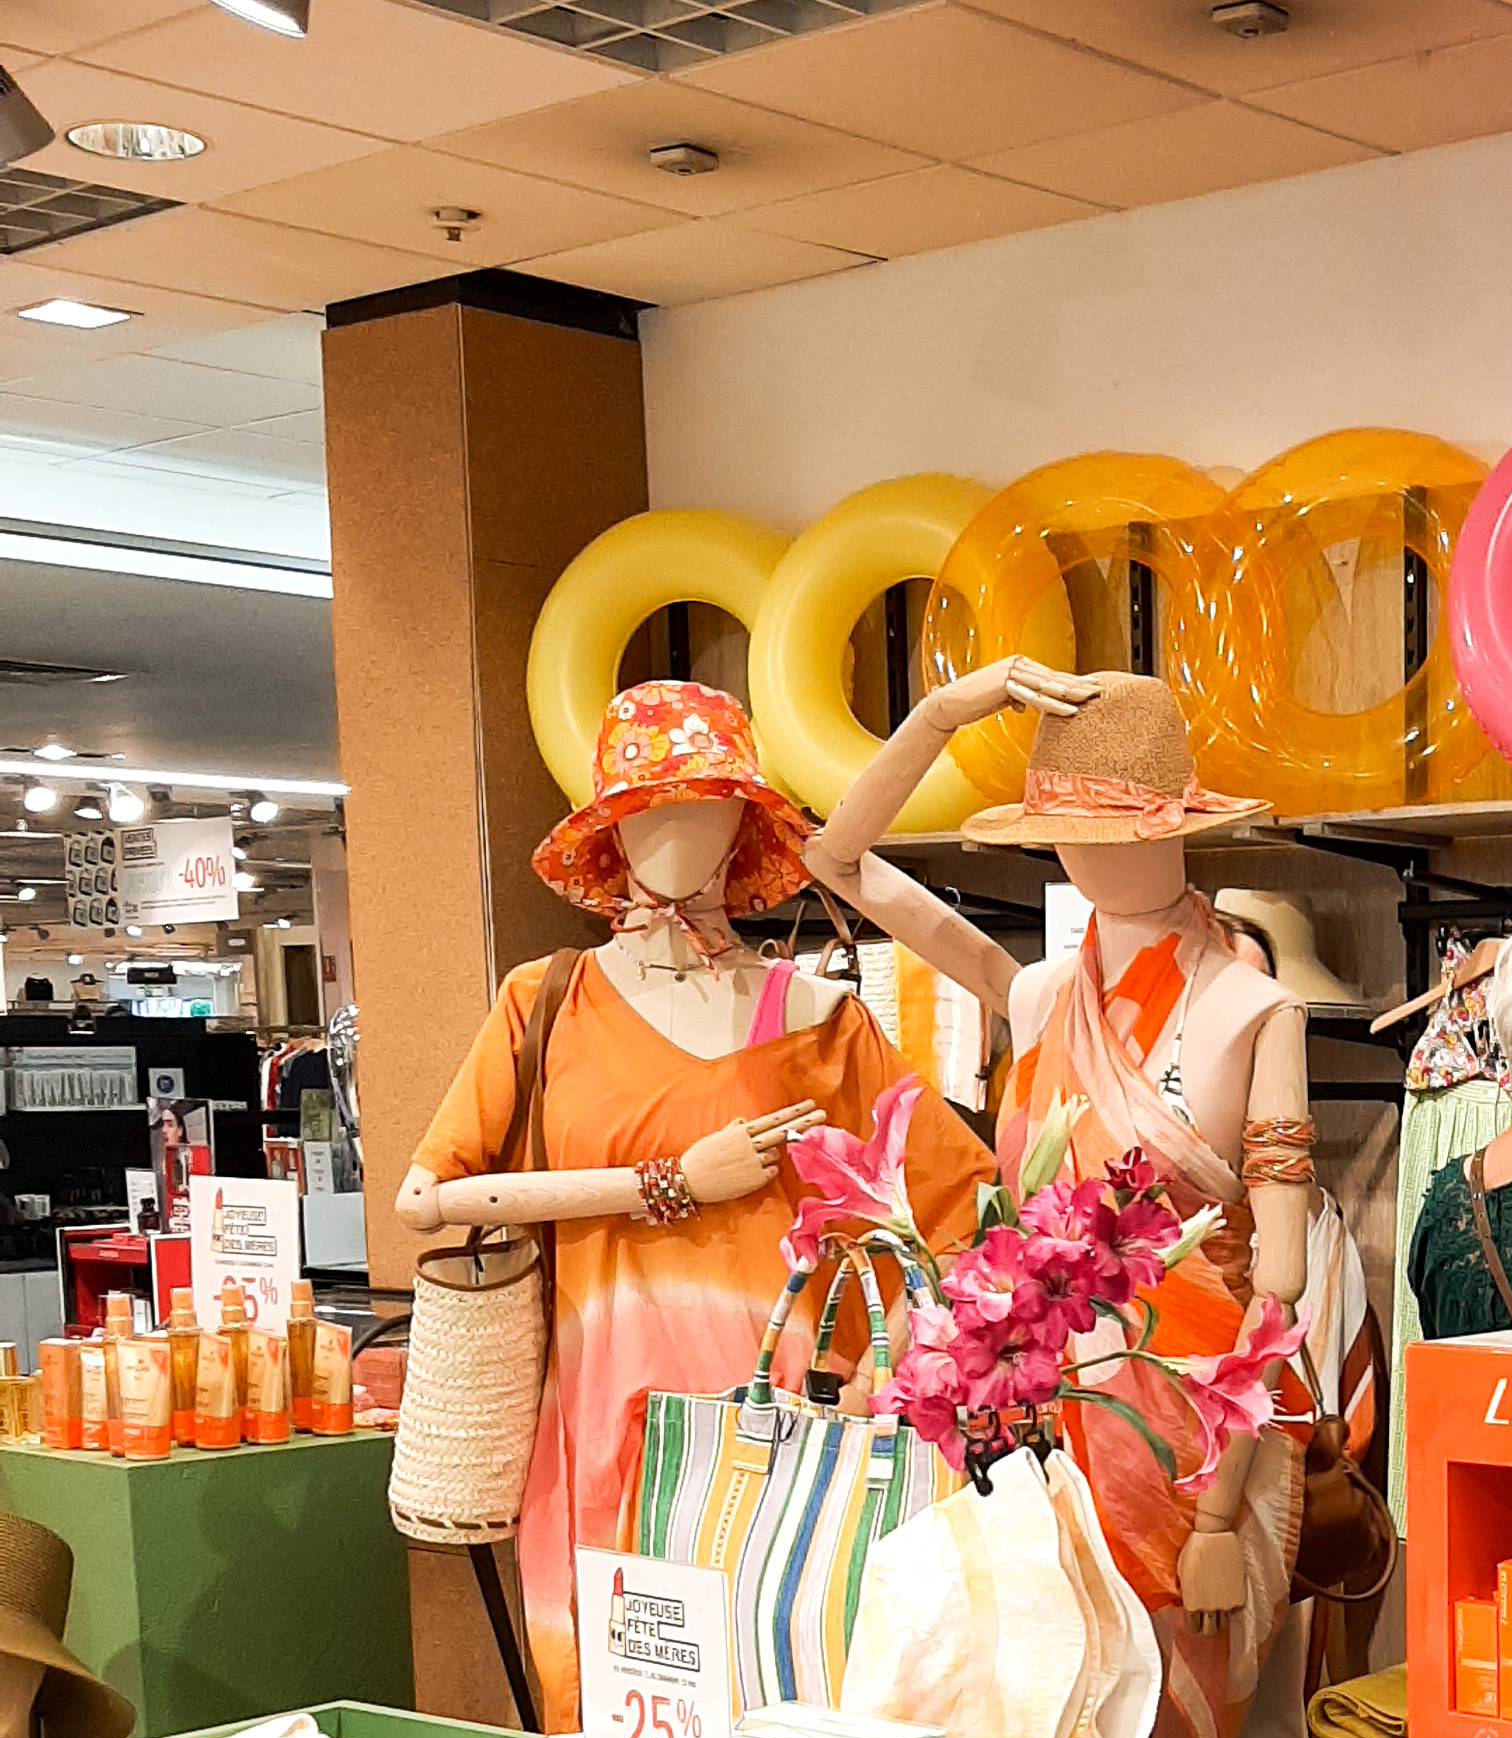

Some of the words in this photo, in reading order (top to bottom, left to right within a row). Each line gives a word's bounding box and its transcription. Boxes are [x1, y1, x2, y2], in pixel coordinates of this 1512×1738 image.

[179, 855, 226, 888] -40%
[626, 1598, 681, 1621] JOYEUSE
[627, 1616, 657, 1637] FÊTE
[628, 1639, 651, 1656] DES
[654, 1641, 696, 1665] MÈRES
